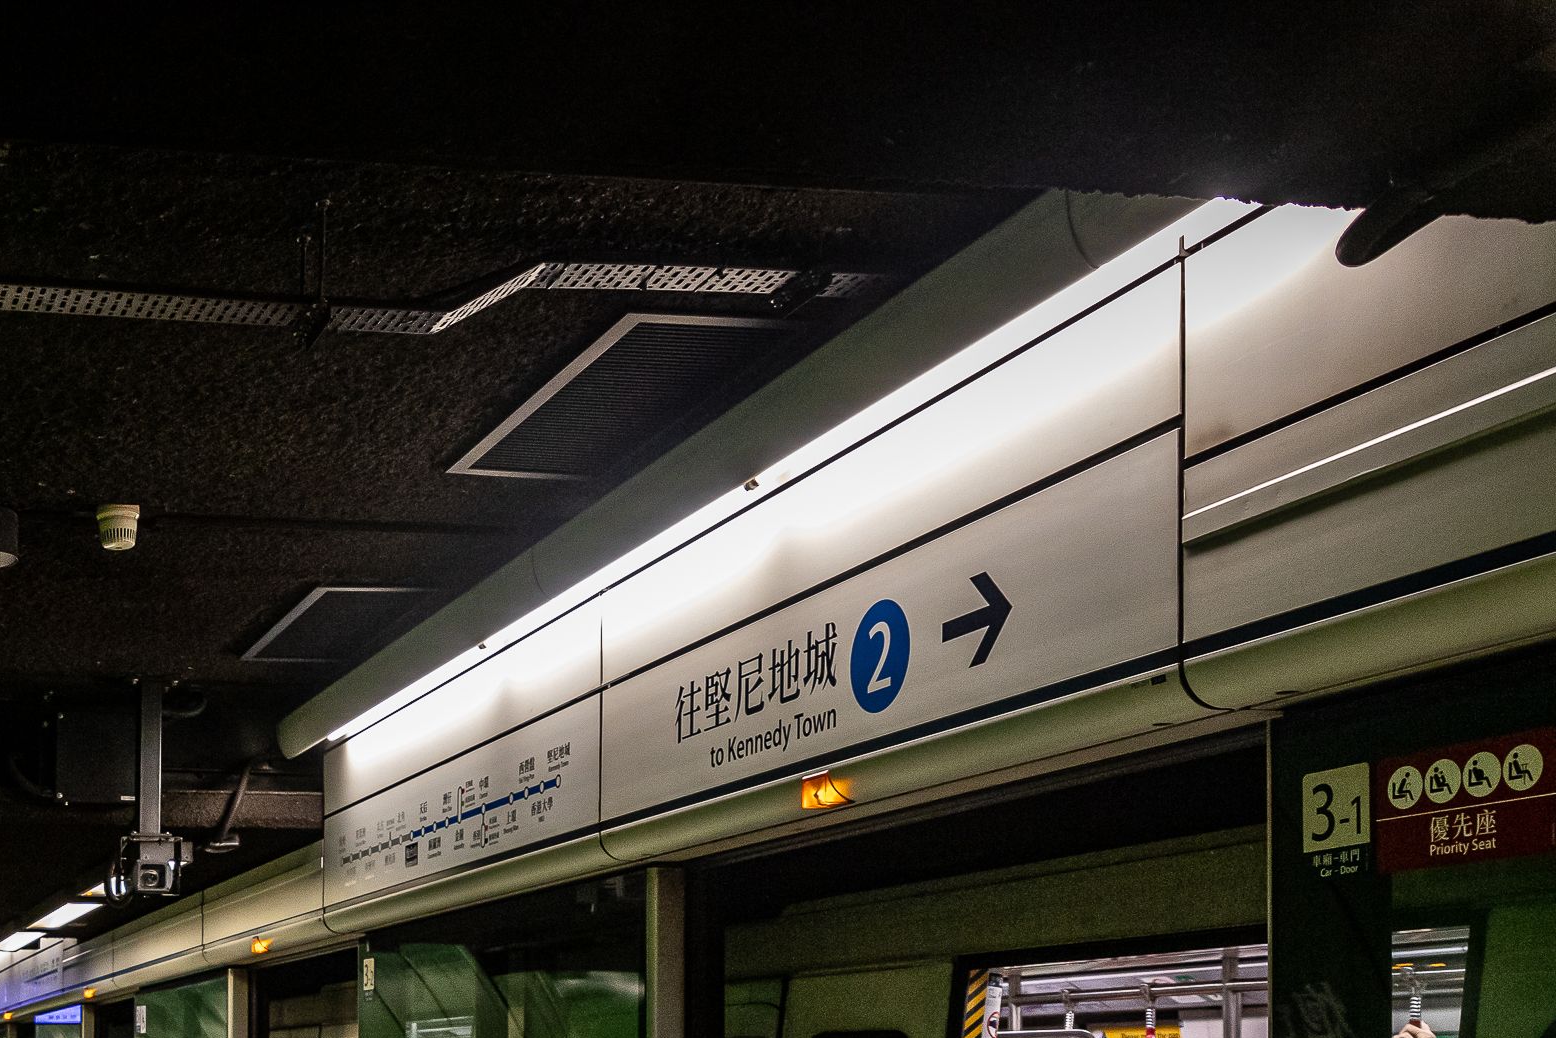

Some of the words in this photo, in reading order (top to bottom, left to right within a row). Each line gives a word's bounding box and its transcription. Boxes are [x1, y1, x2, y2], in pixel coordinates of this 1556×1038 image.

[674, 622, 838, 744] 往堅尼地城
[867, 621, 892, 694] 2
[710, 747, 724, 768] to
[727, 719, 791, 763] Kennedy
[794, 708, 838, 740] Town
[1311, 783, 1362, 842] 3-1
[1430, 809, 1497, 843] 優先座
[1320, 865, 1333, 878] Car
[1340, 864, 1358, 875] Door
[1429, 841, 1469, 857] Priority
[1472, 837, 1497, 851] Seat
